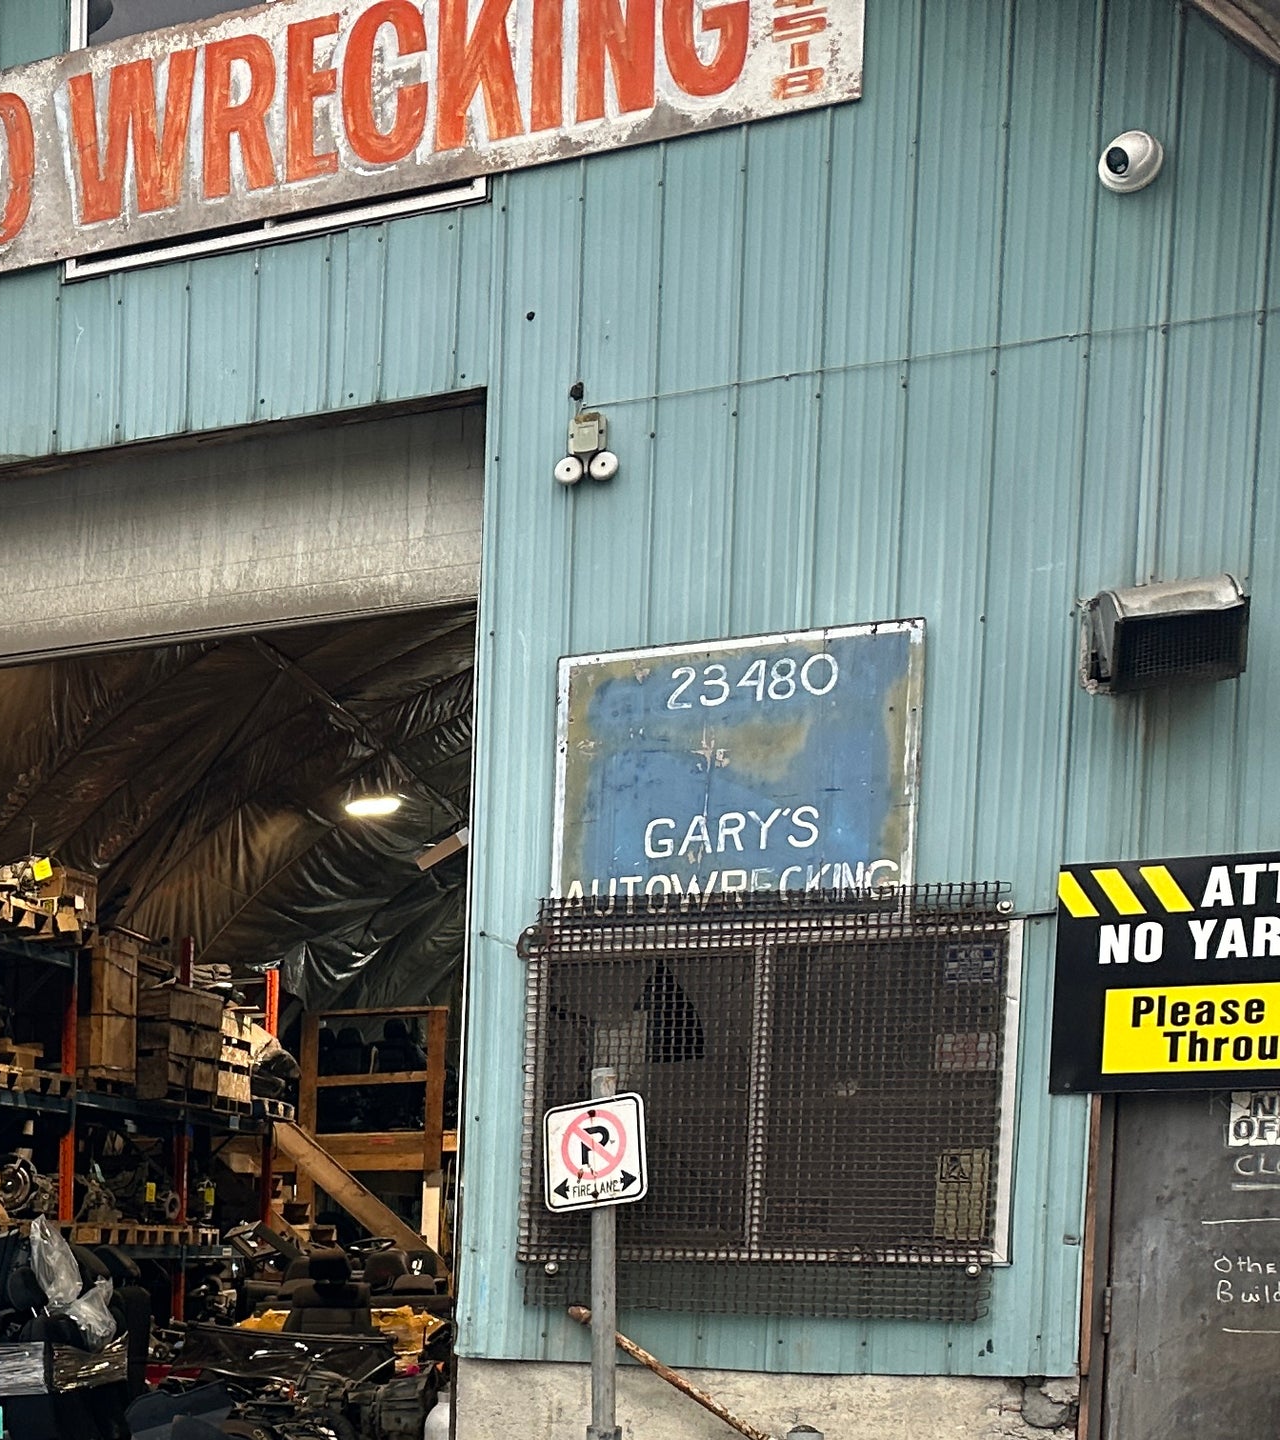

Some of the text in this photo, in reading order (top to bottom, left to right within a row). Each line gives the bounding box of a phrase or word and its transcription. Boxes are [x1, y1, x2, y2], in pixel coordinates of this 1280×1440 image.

[771, 0, 828, 100] 518
[68, 0, 752, 224] WRECKING
[666, 653, 839, 711] 23480
[644, 805, 820, 859] GARY'S
[1098, 916, 1280, 965] NO YAR
[1131, 996, 1266, 1028] Please
[1162, 1031, 1280, 1063] Throu
[572, 1183, 592, 1199] FIRE
